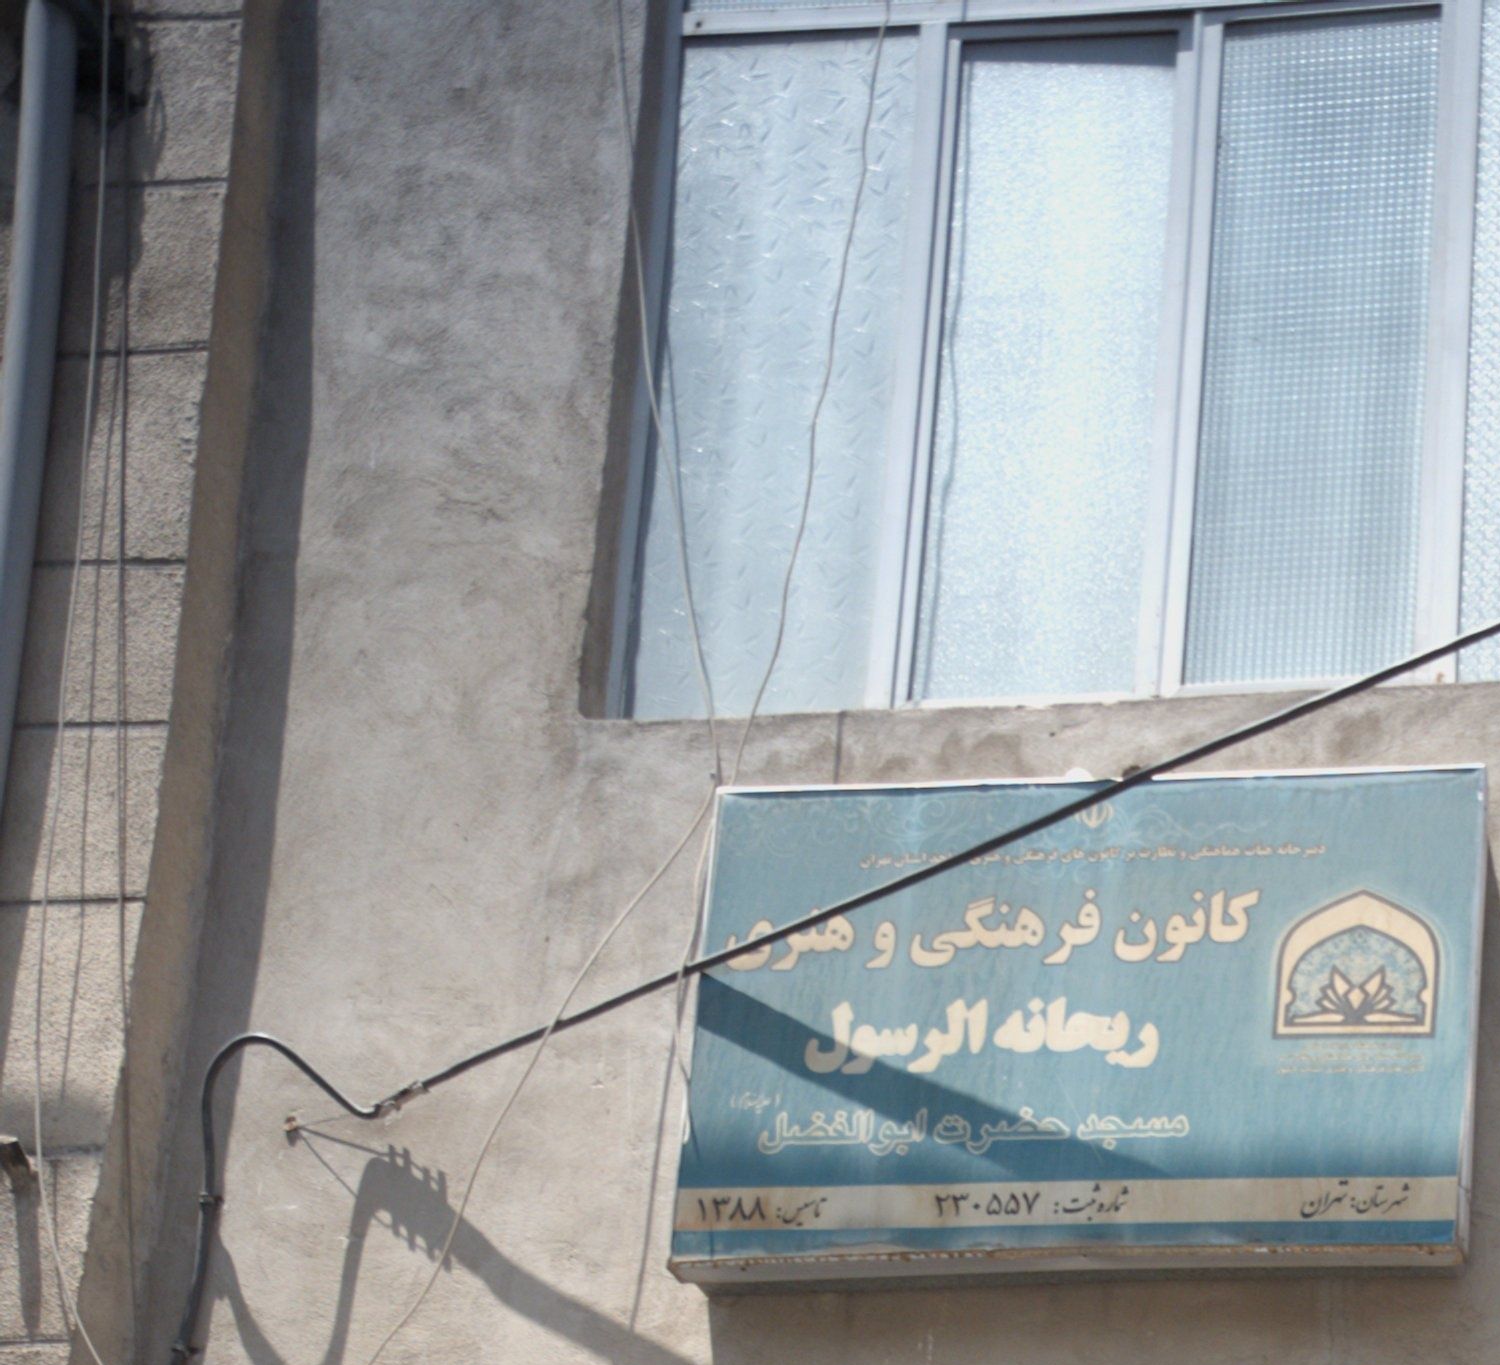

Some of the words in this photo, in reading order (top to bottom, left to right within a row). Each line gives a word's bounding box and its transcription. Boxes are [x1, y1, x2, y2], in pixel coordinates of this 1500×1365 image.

[724, 905, 857, 972] هنری
[864, 918, 898, 970] و
[909, 887, 1102, 969] فرهنگی
[1112, 888, 1262, 965] کانون
[802, 997, 989, 1075] الرسول
[991, 996, 1162, 1070] ریحانه
[757, 1106, 929, 1157] ابوالفضل
[932, 1105, 1072, 1156] حضرت
[1075, 1110, 1191, 1152] مسجد
[696, 1196, 768, 1223] ۱۳۸۸
[934, 1191, 1041, 1220] ۲۳۰۵۵۷
[1300, 1179, 1350, 1220] تهران
